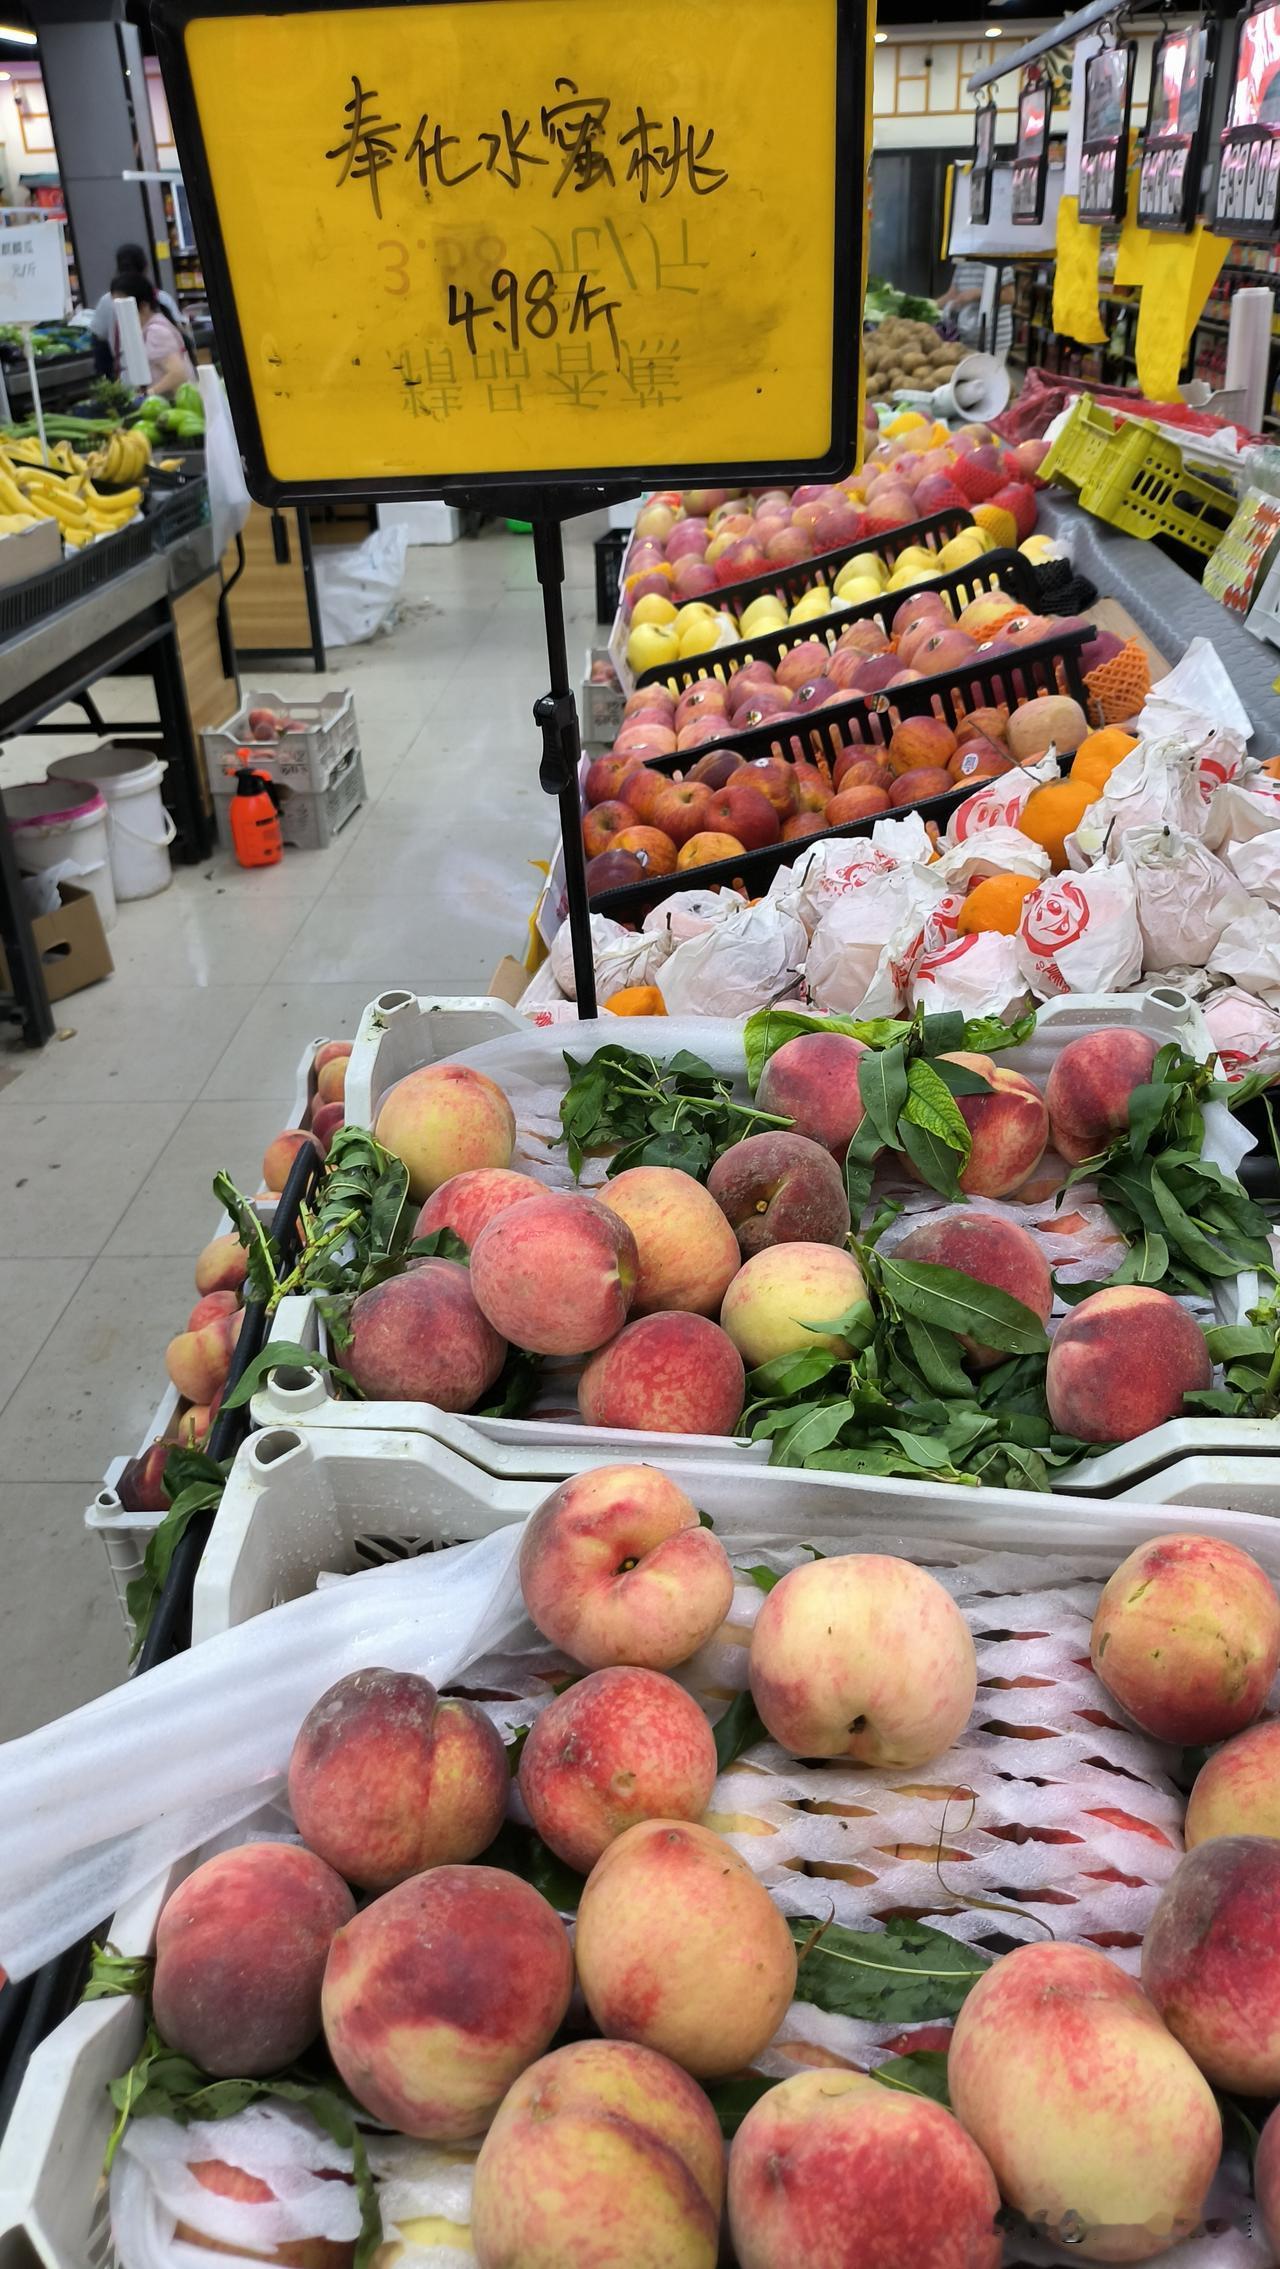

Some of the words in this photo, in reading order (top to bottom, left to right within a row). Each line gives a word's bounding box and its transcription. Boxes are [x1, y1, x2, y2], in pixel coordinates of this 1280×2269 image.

[326, 75, 729, 219] 奉化水蜜桃
